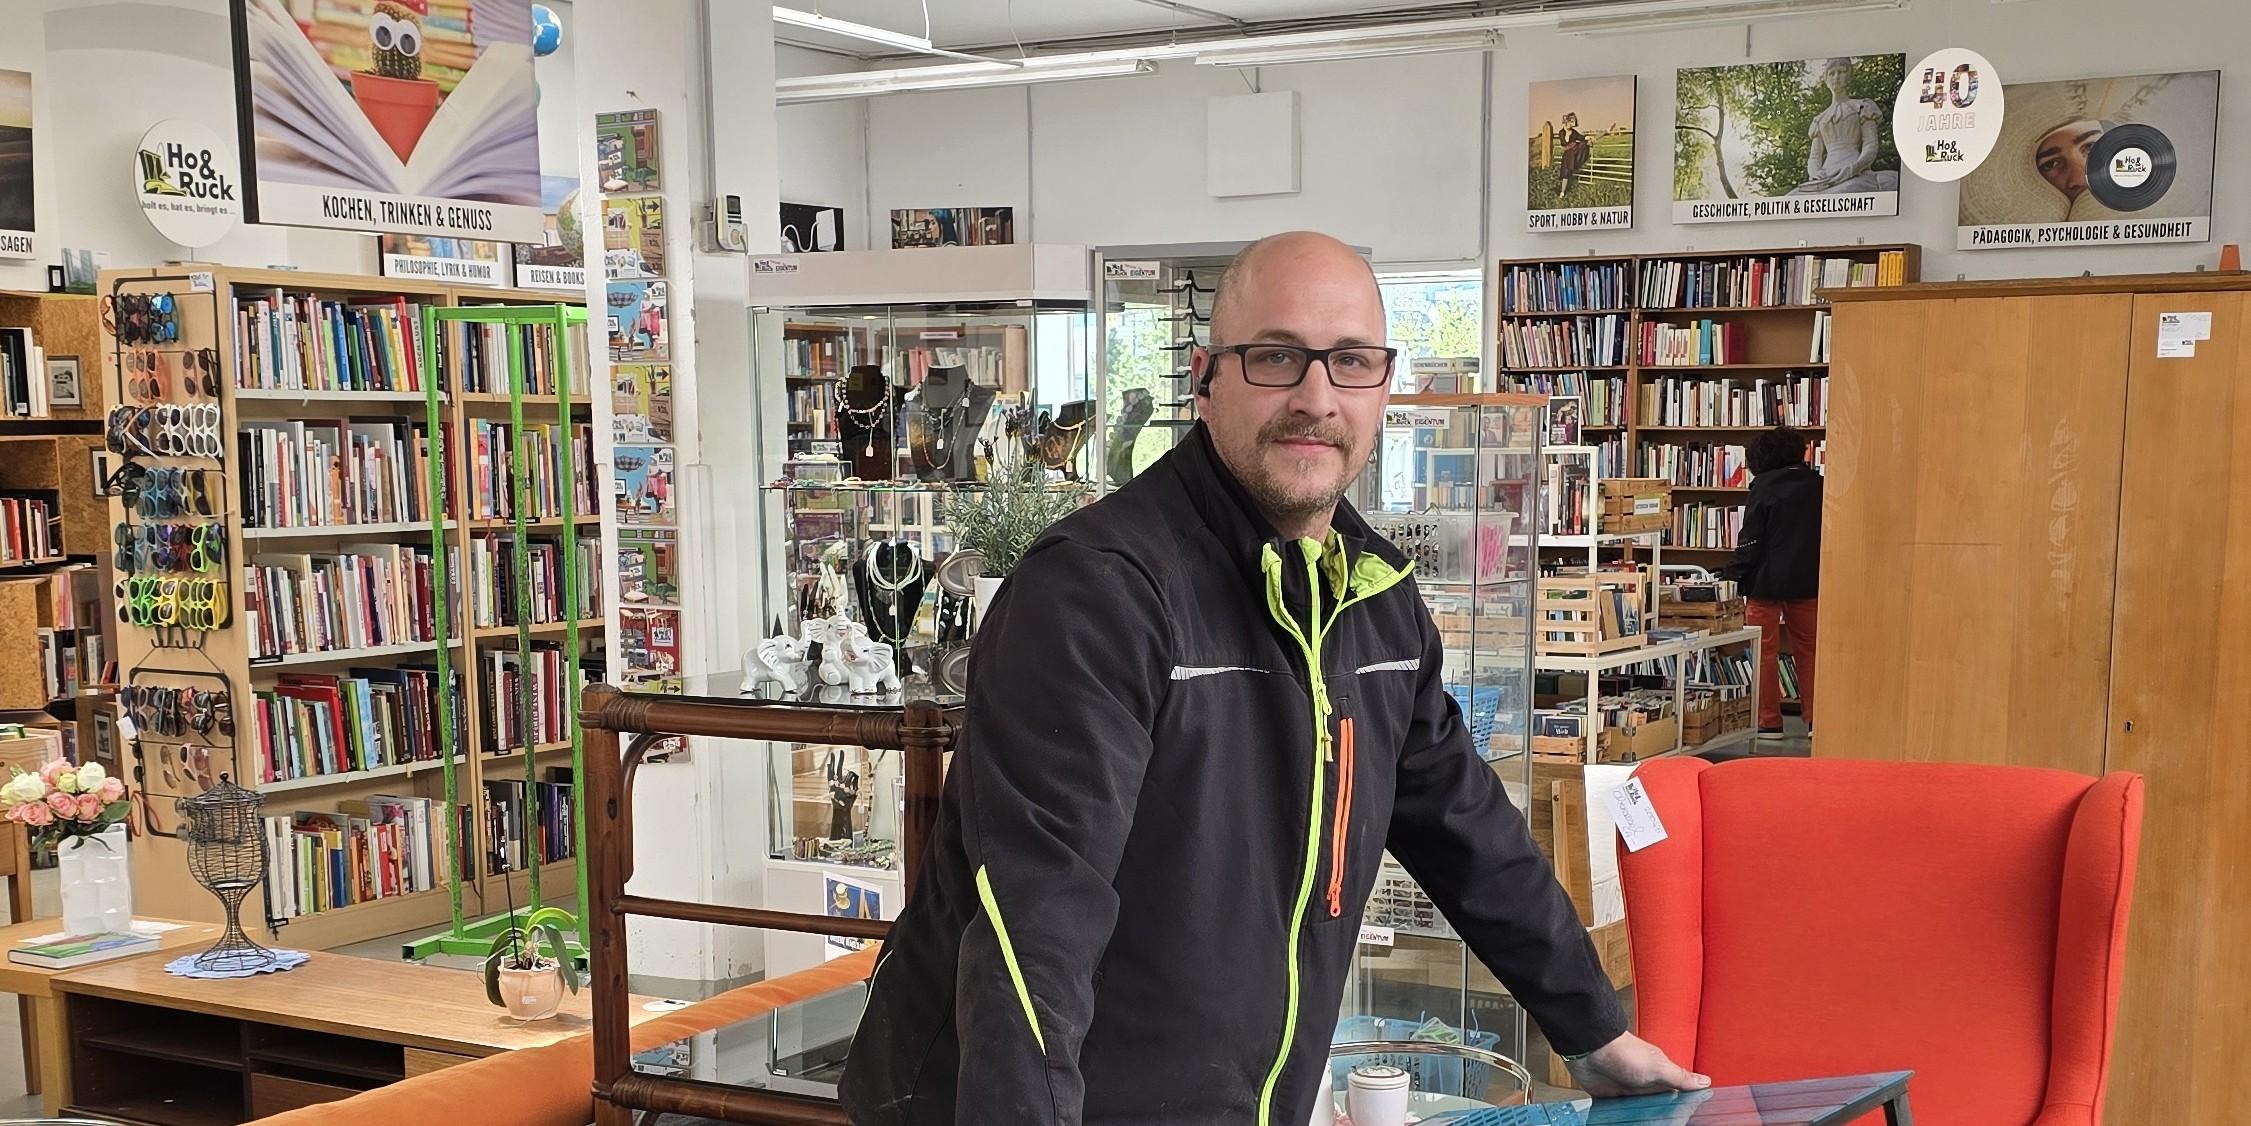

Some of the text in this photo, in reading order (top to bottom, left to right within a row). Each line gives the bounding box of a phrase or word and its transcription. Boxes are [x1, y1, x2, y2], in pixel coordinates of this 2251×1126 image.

[1920, 64, 1979, 109] 40
[1917, 112, 1976, 132] JAHRE
[1937, 140, 1957, 153] Ho&
[1941, 150, 1965, 161] Ruck
[167, 142, 216, 180] Ho&
[179, 171, 234, 200] Ruck
[323, 194, 492, 230] KOCHEN, TRINKEN & GENUSS
[1693, 197, 1875, 218] GESCHICHTE, POLITIK & GESELLSCHAFT
[1529, 211, 1628, 228] SPORT, HOBBY & NATUR
[1972, 222, 2192, 245] PÄDAGOGIK, PSYCHOLOGIE & GESUNDHEIT
[1, 236, 32, 253] SAGEN
[394, 259, 491, 278] PHILOSOPHIE, LYRIK & HUMOR
[531, 270, 554, 283] REISEN
[557, 272, 561, 283] &
